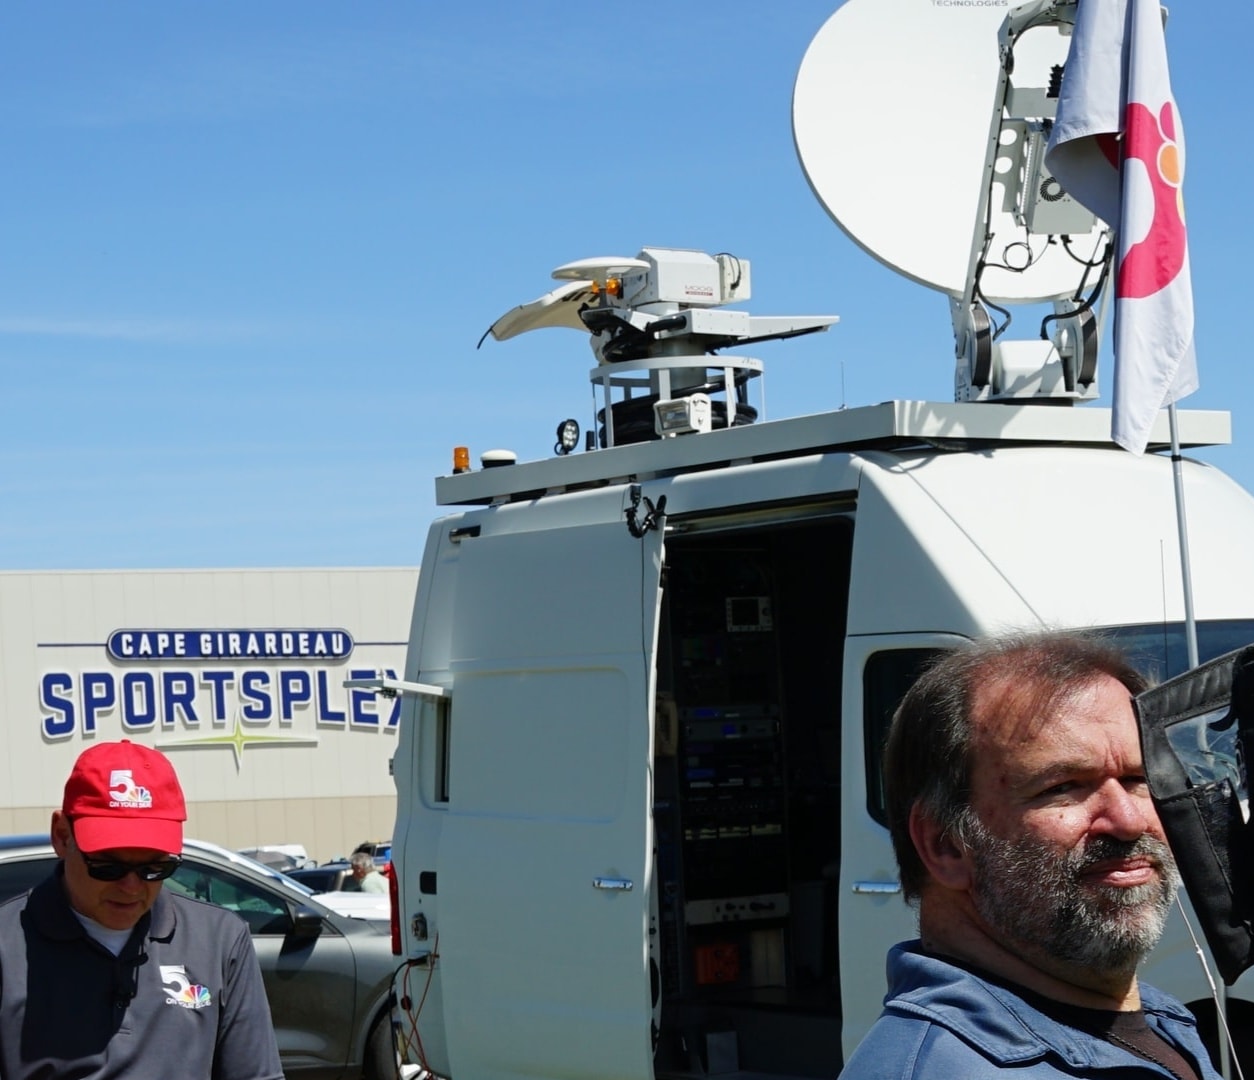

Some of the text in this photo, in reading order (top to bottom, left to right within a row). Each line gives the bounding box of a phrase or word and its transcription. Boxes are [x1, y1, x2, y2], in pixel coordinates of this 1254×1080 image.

[121, 633, 344, 656] CAPE GIRARDEAU
[109, 769, 136, 802] 5
[159, 965, 190, 1002] 5
